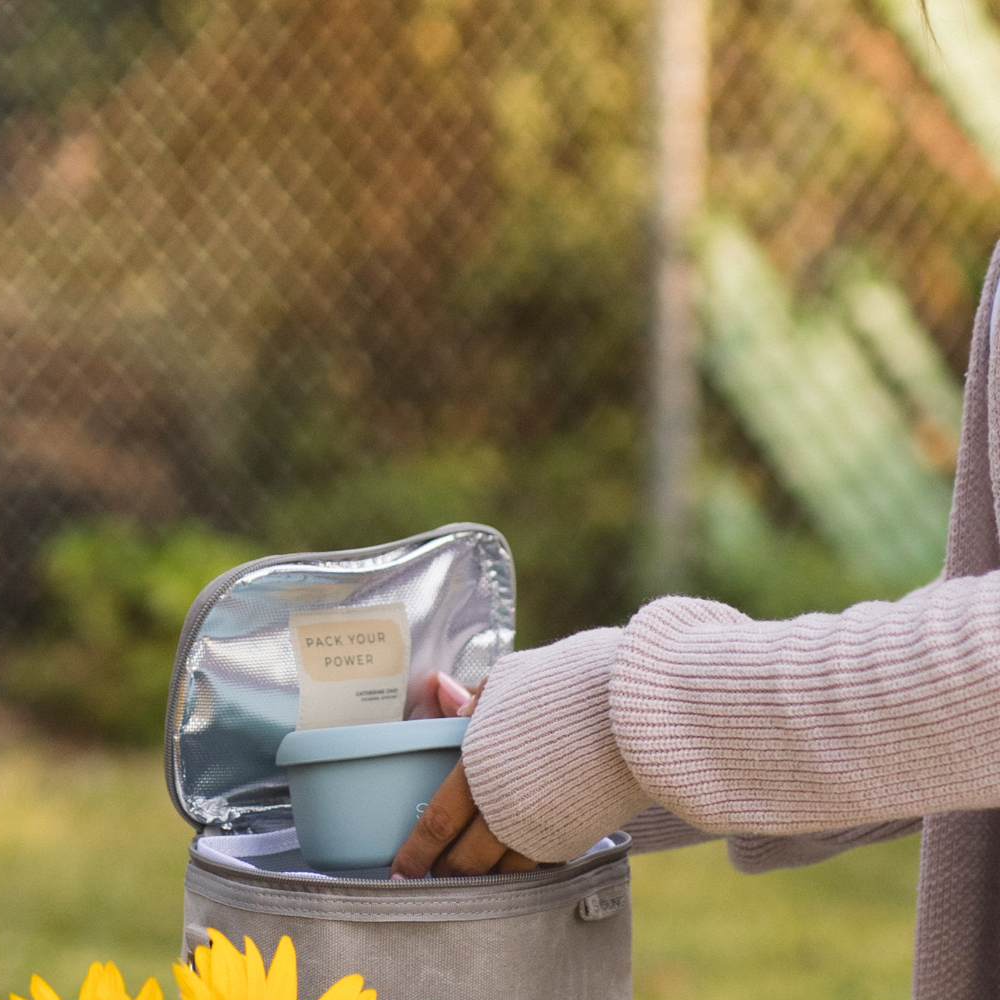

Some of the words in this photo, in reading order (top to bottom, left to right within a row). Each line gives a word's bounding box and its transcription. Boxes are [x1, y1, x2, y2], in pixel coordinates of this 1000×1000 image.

[305, 635, 344, 648] PACK
[347, 632, 386, 645] YOUR
[324, 654, 374, 667] POWER
